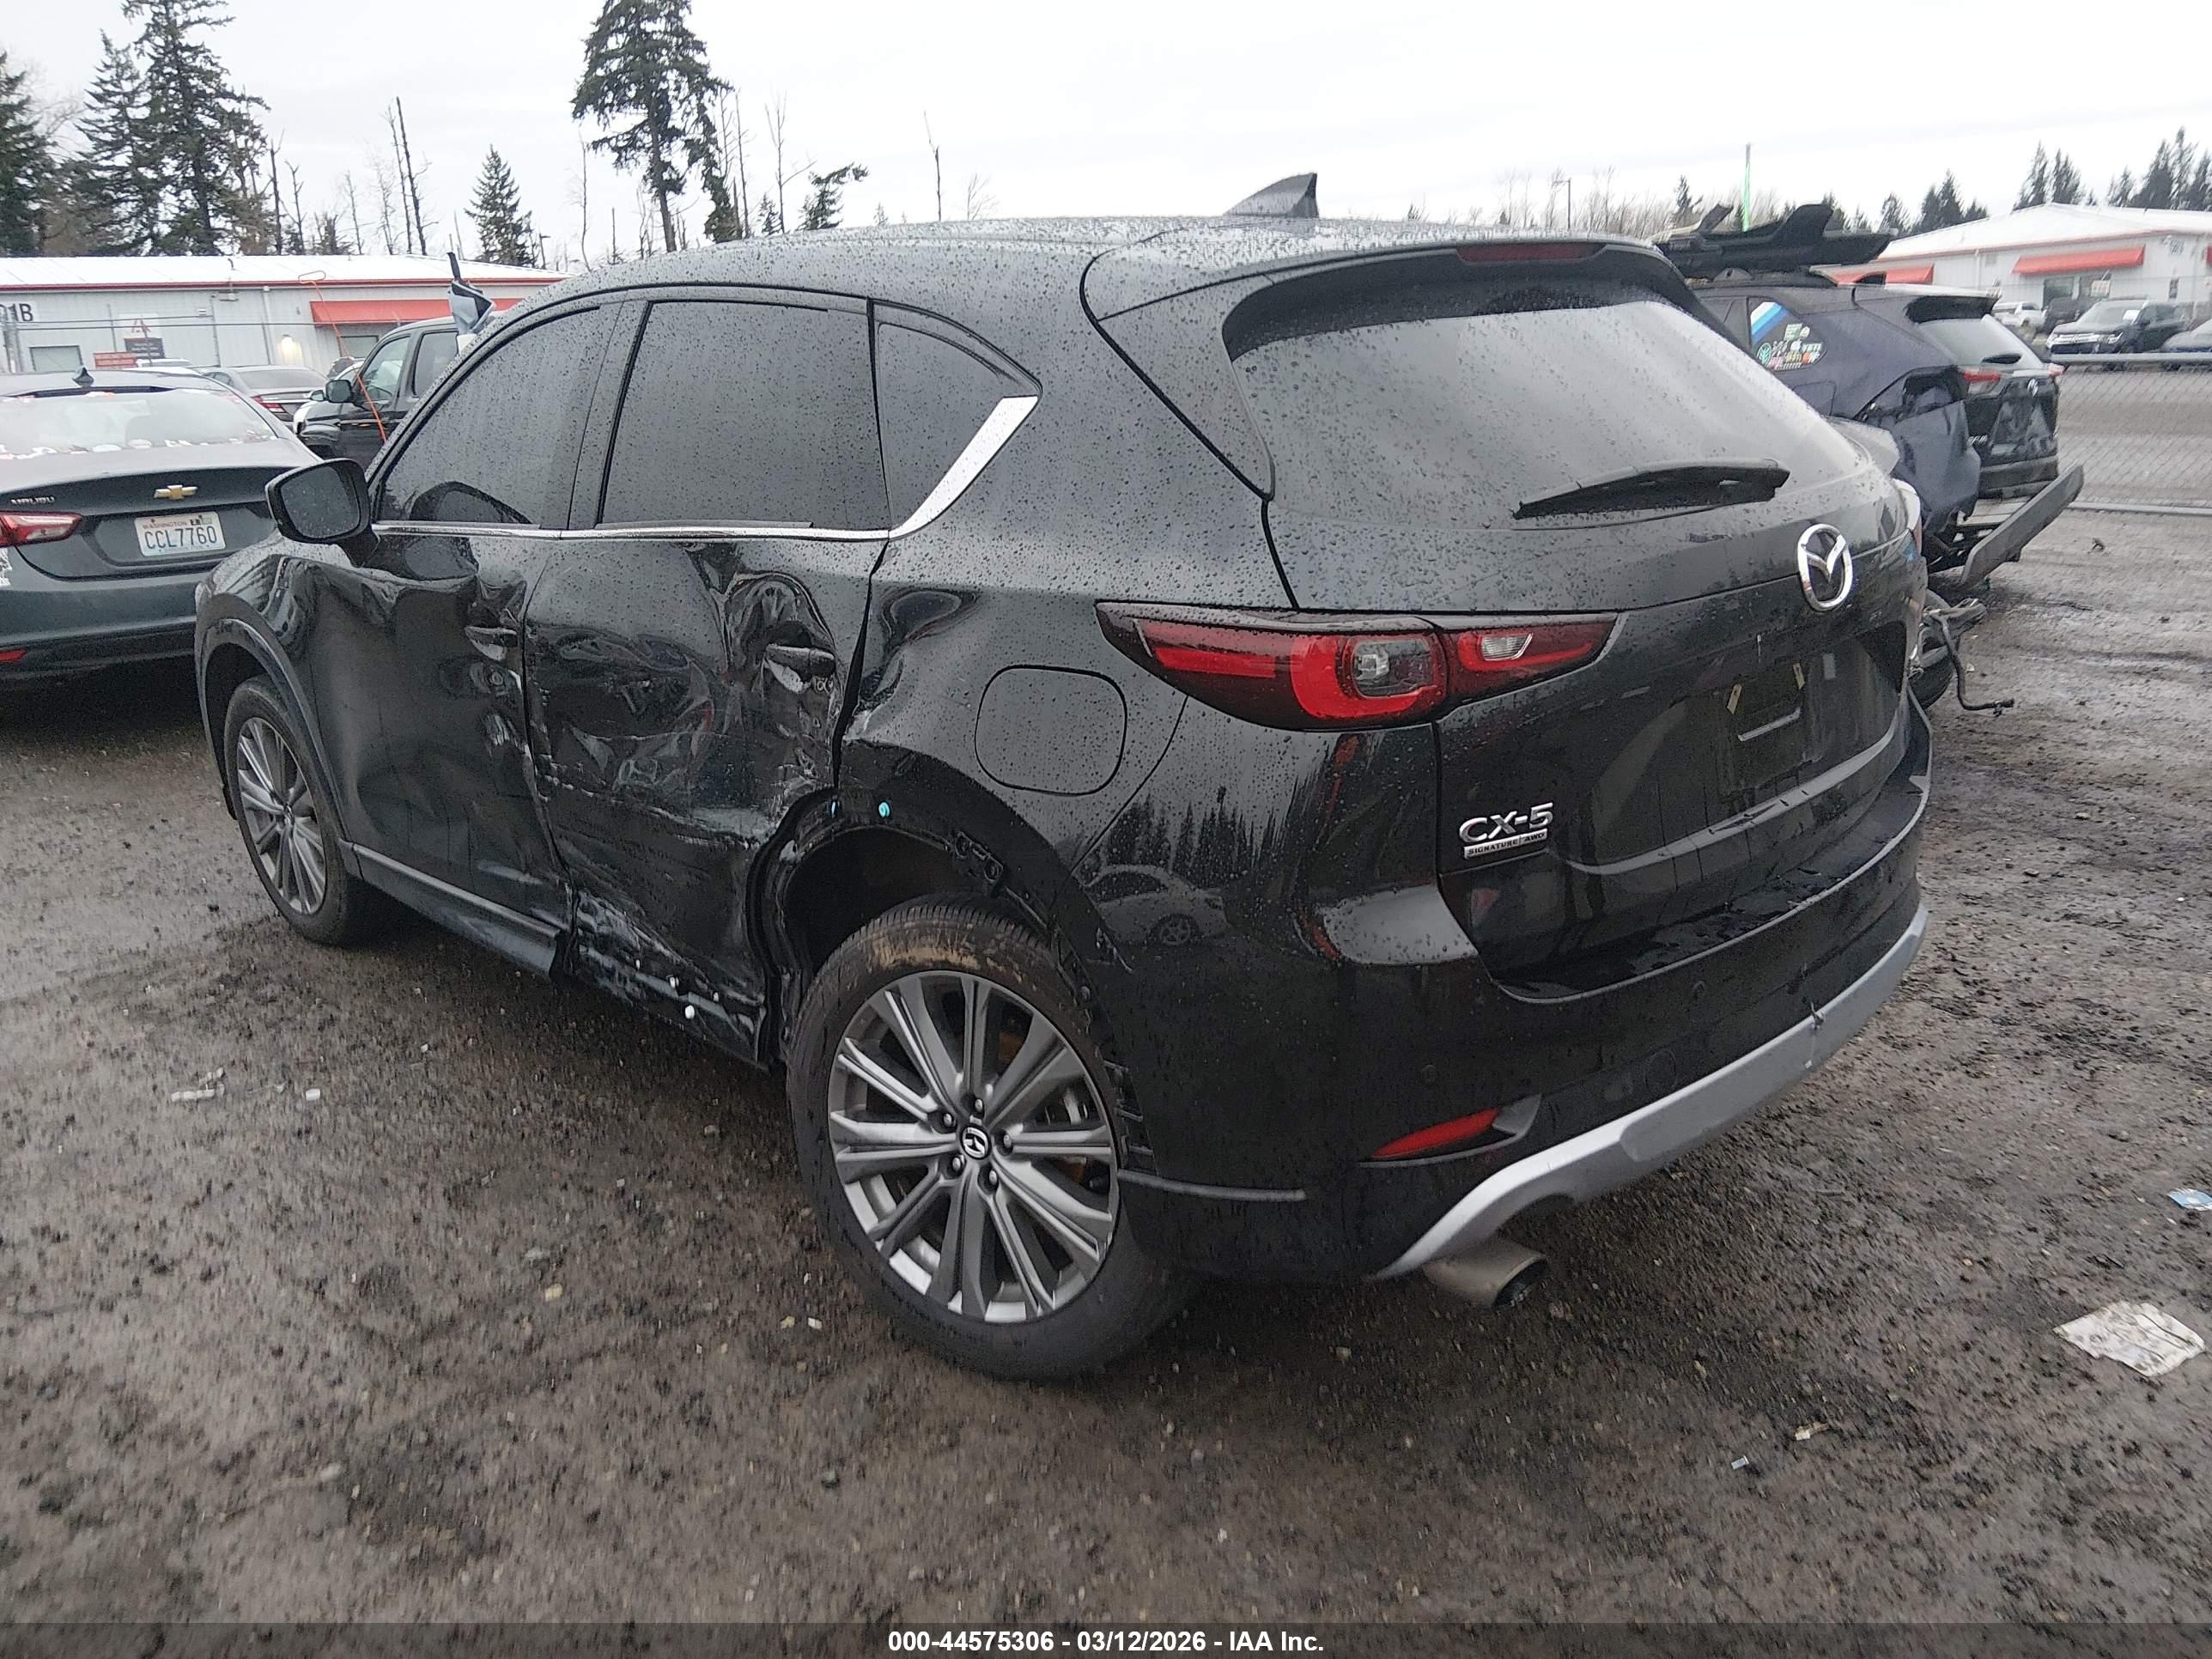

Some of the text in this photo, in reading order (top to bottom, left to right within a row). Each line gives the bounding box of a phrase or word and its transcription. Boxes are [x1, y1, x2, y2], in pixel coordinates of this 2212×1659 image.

[144, 526, 217, 549] CCL7760
[1459, 802, 1553, 843] CX-5
[1468, 831, 1546, 855] SIGNATURE AWD
